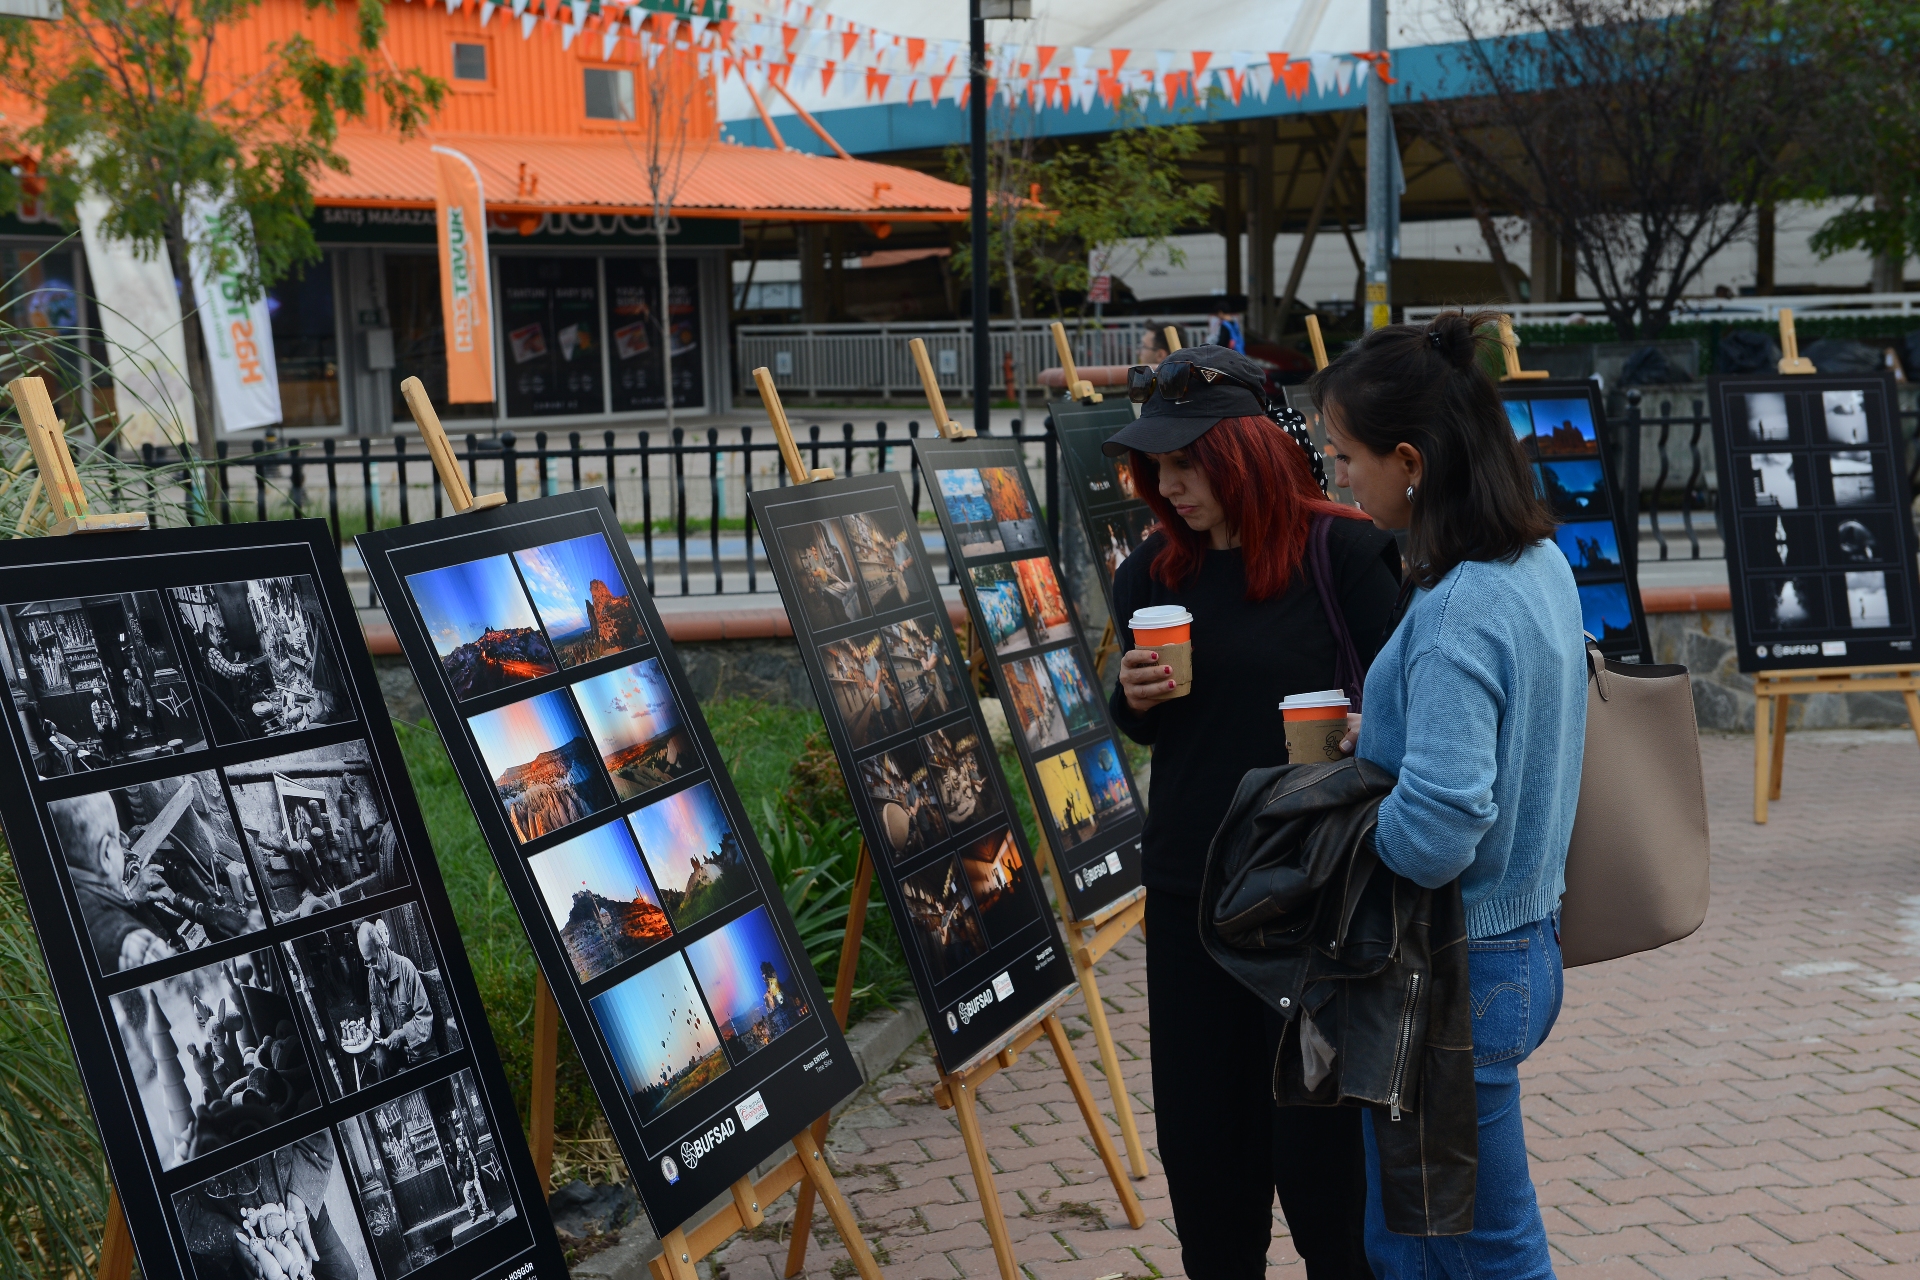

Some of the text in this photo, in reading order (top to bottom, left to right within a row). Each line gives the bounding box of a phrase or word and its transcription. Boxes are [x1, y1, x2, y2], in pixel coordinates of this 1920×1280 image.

[367, 206, 437, 225] MAĞAZA
[1782, 644, 1819, 656] BUFSAD
[966, 988, 994, 1017] BUFSAD
[693, 1117, 736, 1159] BUFSAD
[508, 1262, 534, 1280] HOŞGÖR
